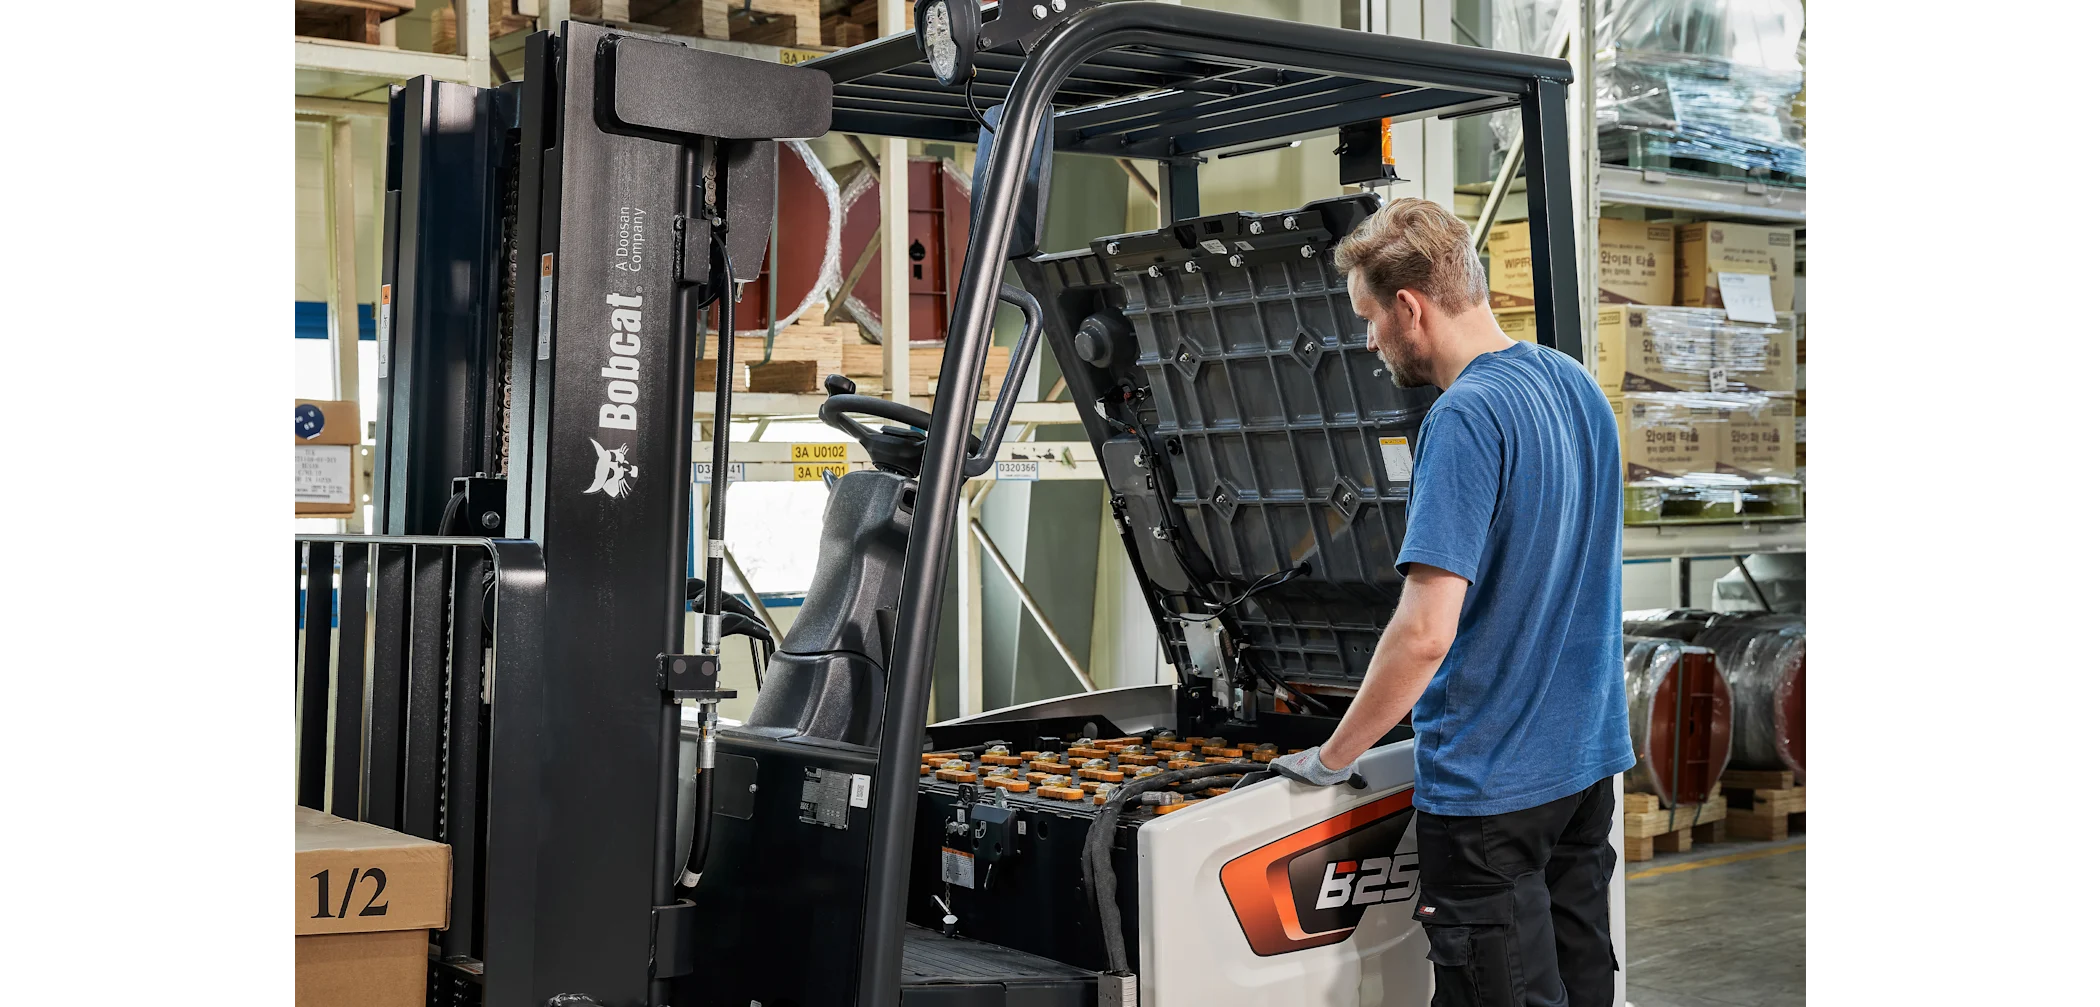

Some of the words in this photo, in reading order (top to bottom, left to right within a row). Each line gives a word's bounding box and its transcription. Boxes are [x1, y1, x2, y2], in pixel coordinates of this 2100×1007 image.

[783, 52, 798, 64] 3A
[615, 206, 630, 257] Doosan
[628, 207, 647, 272] Company
[615, 261, 628, 272] A
[598, 292, 644, 431] Bobcat
[795, 447, 809, 458] 3A
[814, 446, 845, 458] U0102
[697, 464, 741, 474] D341
[798, 467, 812, 478] 3A
[999, 463, 1036, 472] D320366
[1315, 853, 1420, 910] B25
[310, 867, 389, 919] 1/2
